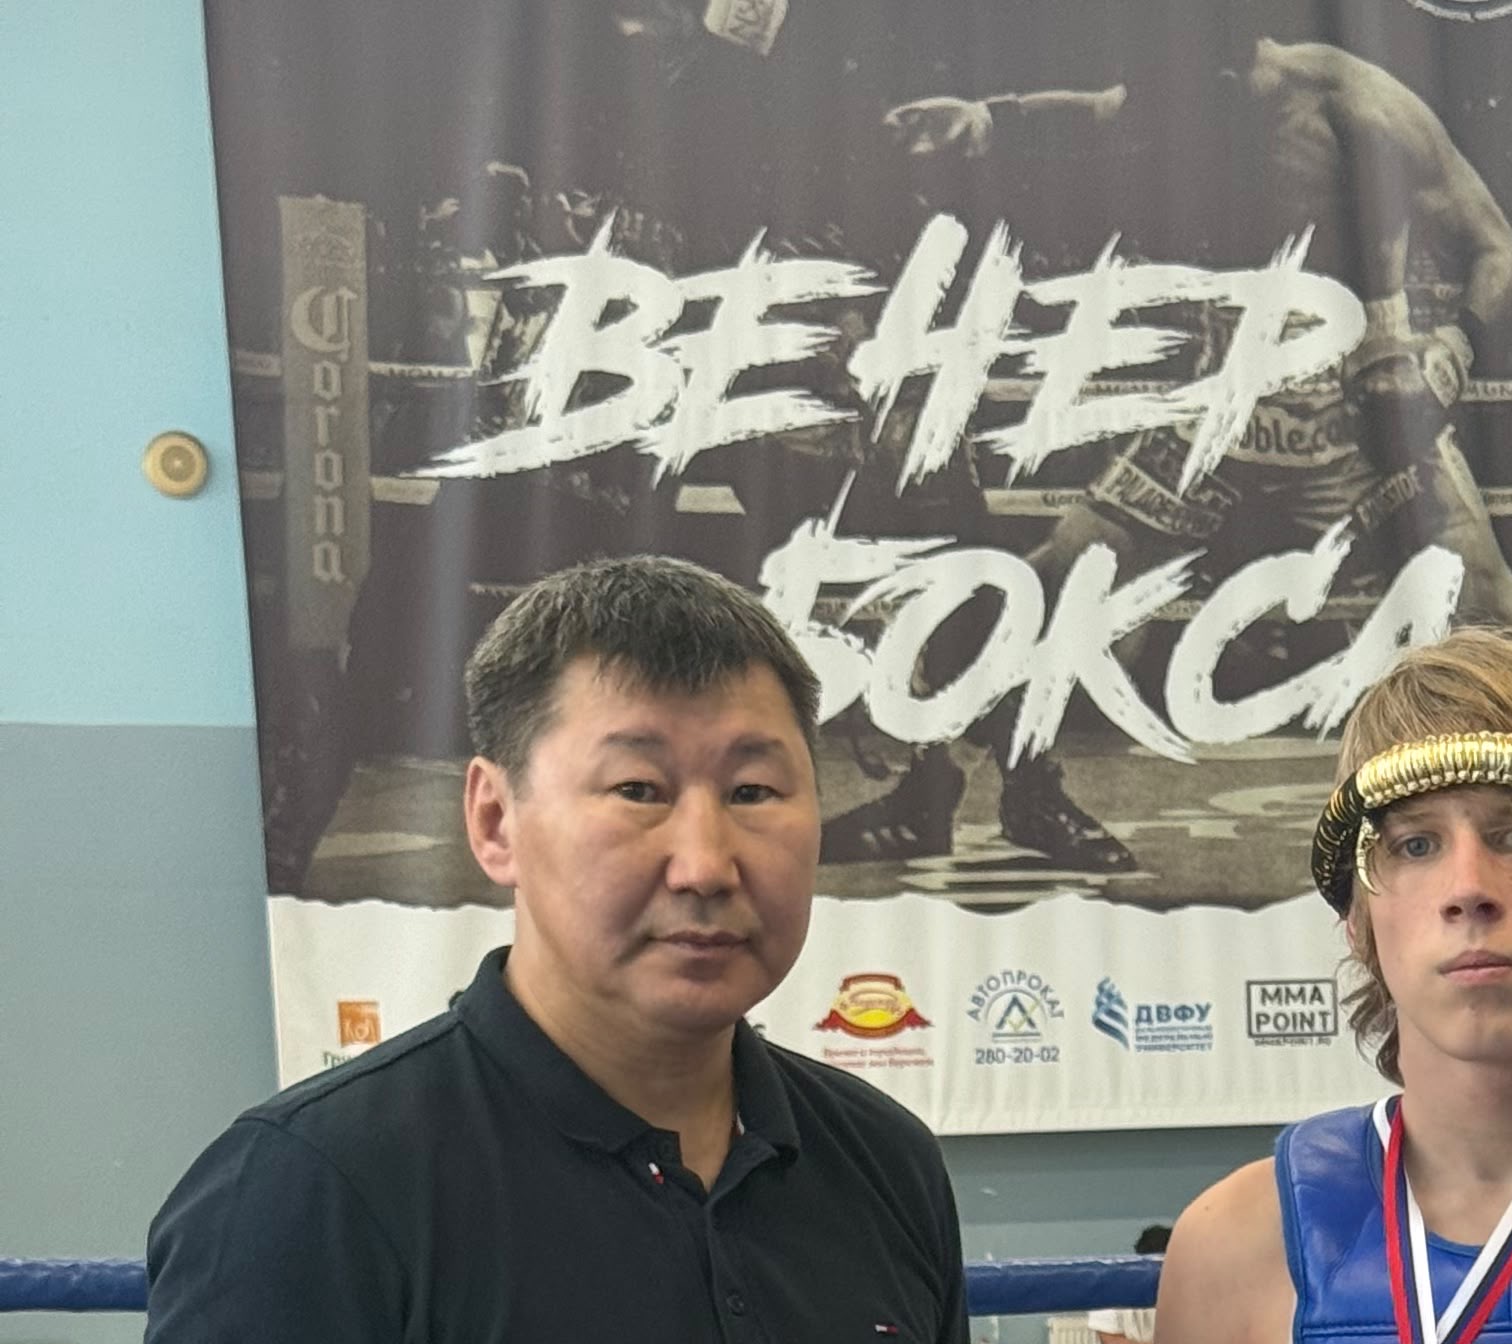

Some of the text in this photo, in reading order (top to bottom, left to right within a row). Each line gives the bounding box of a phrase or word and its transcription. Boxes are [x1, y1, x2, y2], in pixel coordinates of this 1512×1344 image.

[290, 286, 358, 585] Corona
[966, 969, 1064, 1021] АВТОПРОКАТ
[1260, 986, 1325, 1006] MMA
[1135, 1003, 1212, 1025] ДВФУ
[1255, 1012, 1331, 1032] POINT
[975, 1046, 1039, 1064] 280-20-02
